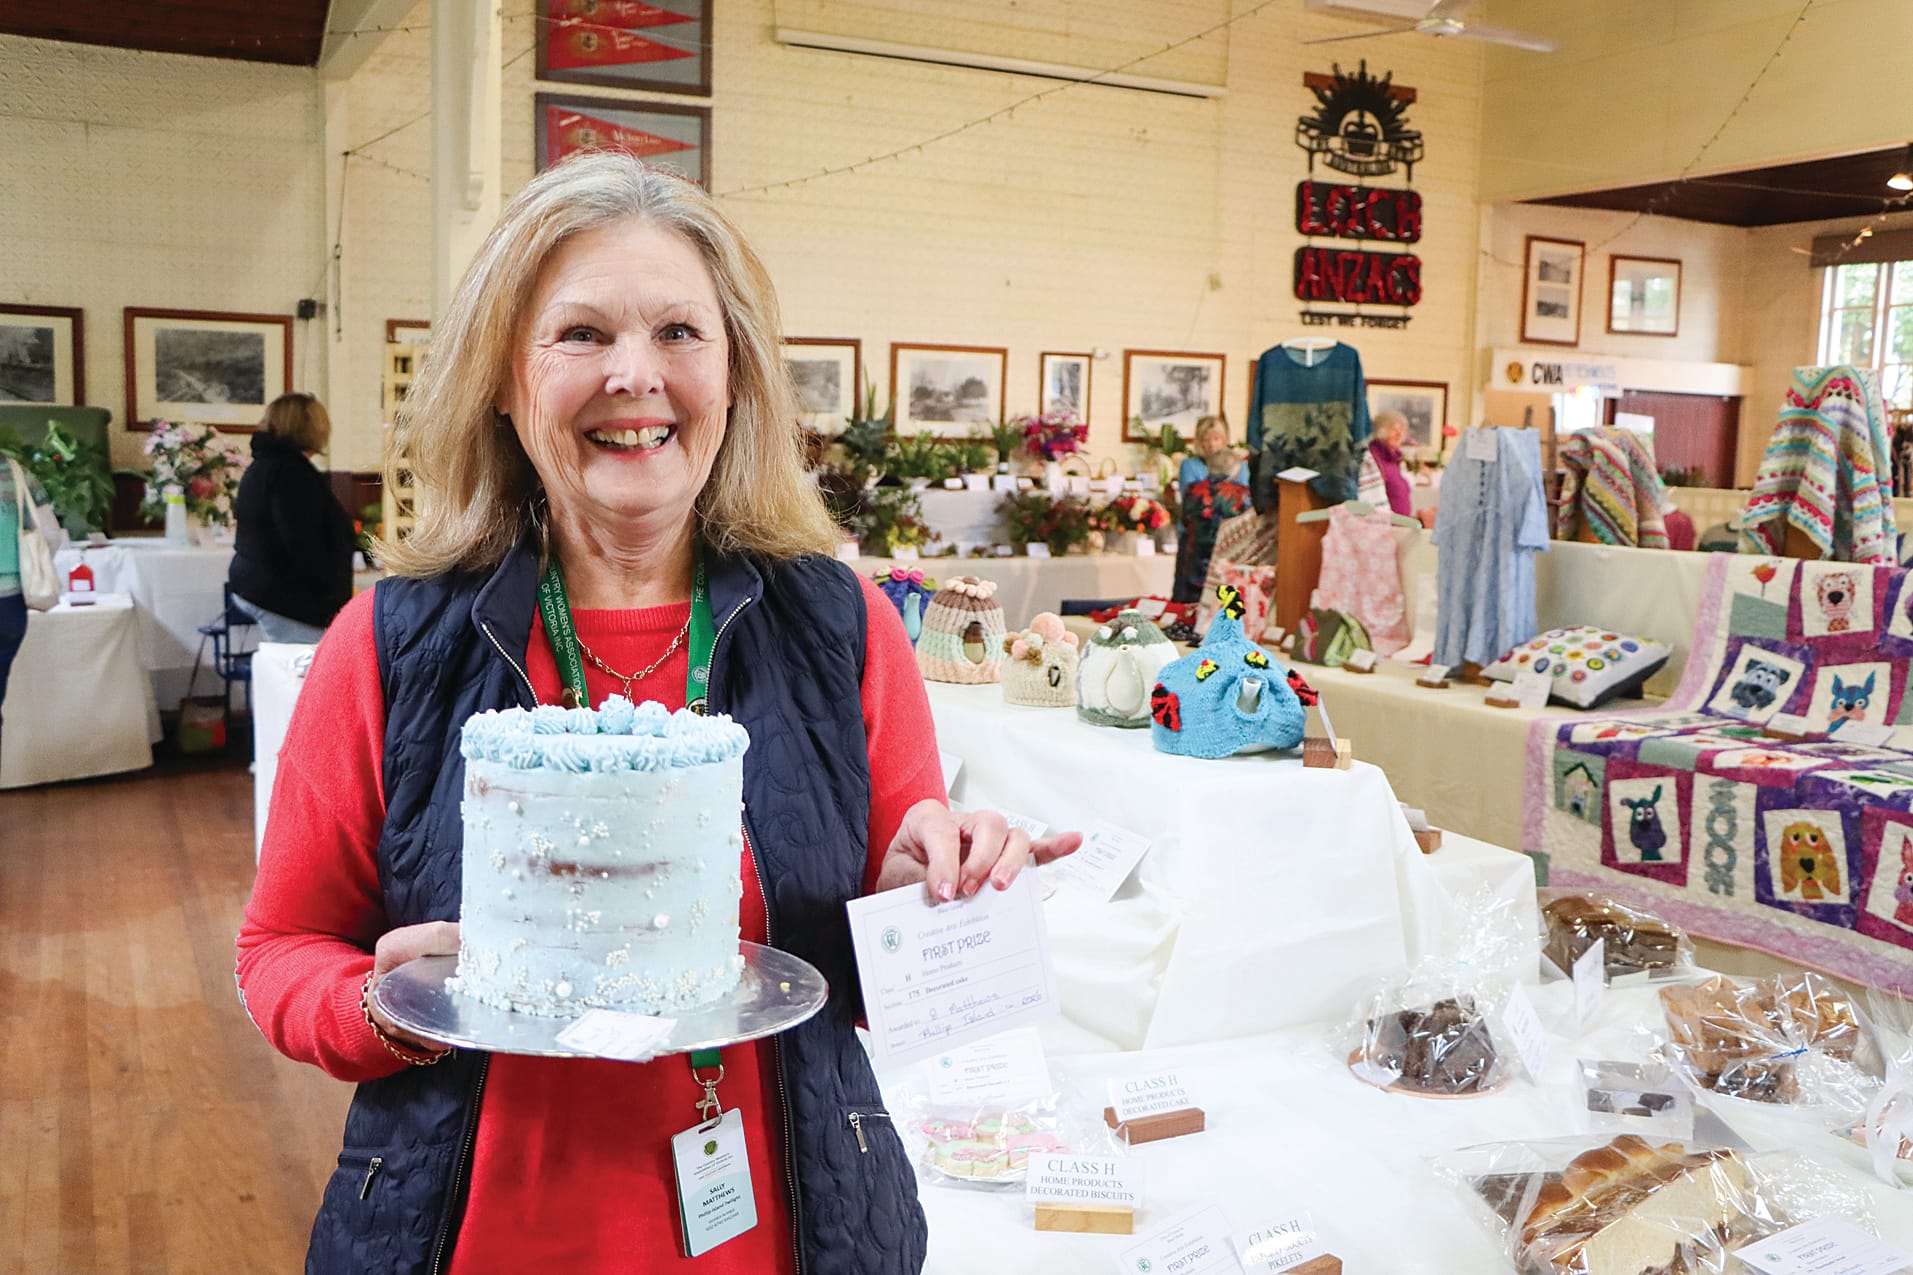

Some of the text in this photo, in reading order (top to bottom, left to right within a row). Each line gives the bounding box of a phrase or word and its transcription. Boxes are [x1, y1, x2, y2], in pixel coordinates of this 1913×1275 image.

[1301, 181, 1421, 242] LOCH
[1296, 248, 1421, 304] ANZACS
[1531, 362, 1565, 385] CWA
[547, 557, 561, 594] OUNTRY
[541, 583, 551, 594] OF
[695, 587, 704, 603] THE
[544, 594, 560, 637] VICTORIA
[922, 929, 991, 962] FIRST PRIZE
[1125, 1074, 1178, 1094] CLASS H
[1121, 1087, 1186, 1106] HOME PRODUCTS
[1122, 1097, 1190, 1117] DECORATED CAKE
[1047, 1159, 1116, 1176] CLASS H
[709, 1183, 725, 1195] SALLY
[1040, 1175, 1124, 1189] HOME PRODUCTS
[702, 1187, 735, 1207] MATTHEWS
[1030, 1186, 1135, 1201] DECORATED BISCUITS
[1248, 1223, 1288, 1246] CLASS
[1289, 1219, 1301, 1232] H
[1268, 1252, 1303, 1270] PIKELETS
